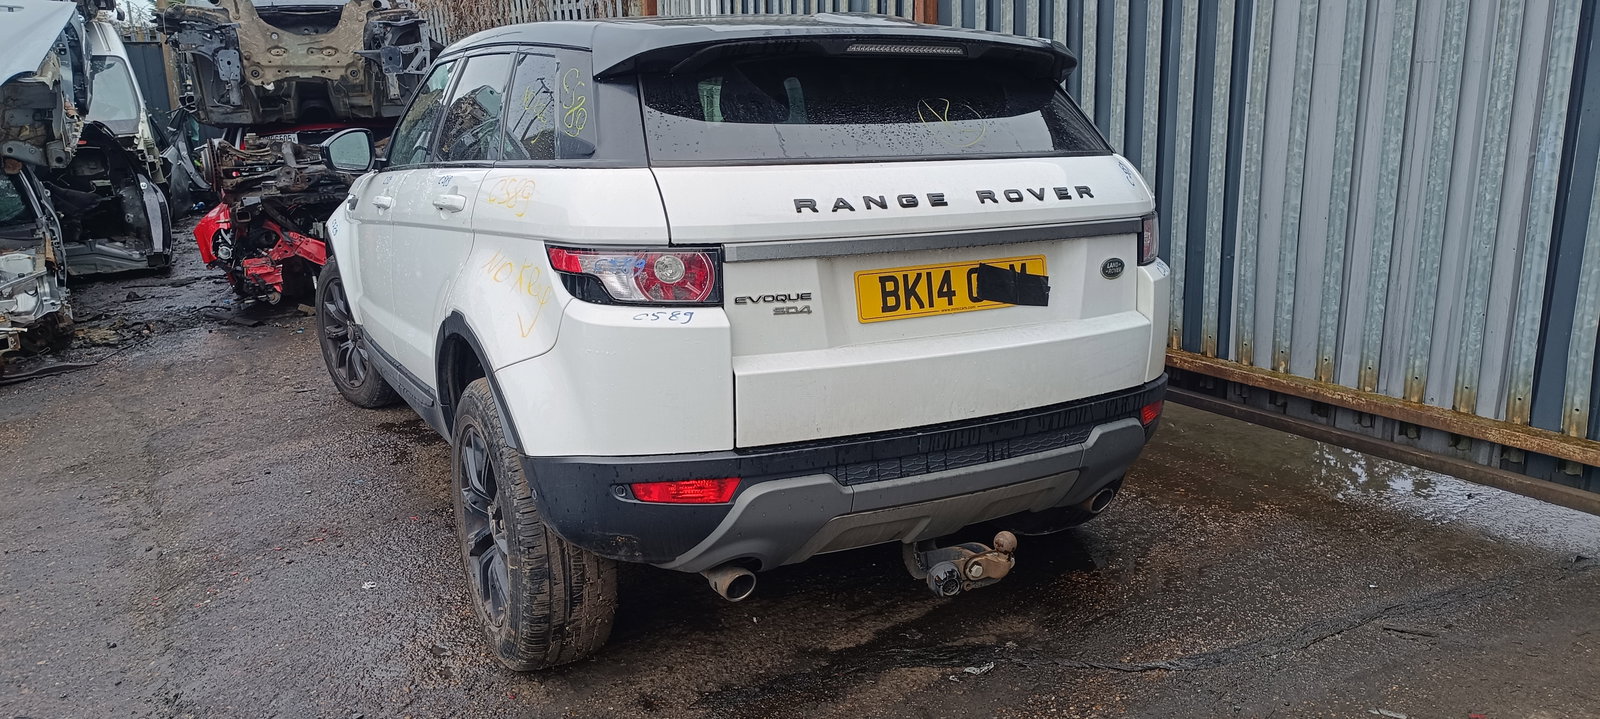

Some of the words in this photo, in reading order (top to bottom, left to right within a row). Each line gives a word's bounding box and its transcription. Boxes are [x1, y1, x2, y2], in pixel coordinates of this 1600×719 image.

[793, 193, 948, 213] RANGE
[976, 185, 1094, 204] ROVER
[734, 292, 812, 304] EVOQUE
[879, 270, 956, 313] BK14
[773, 305, 812, 315] SD4
[633, 311, 694, 324] C589
